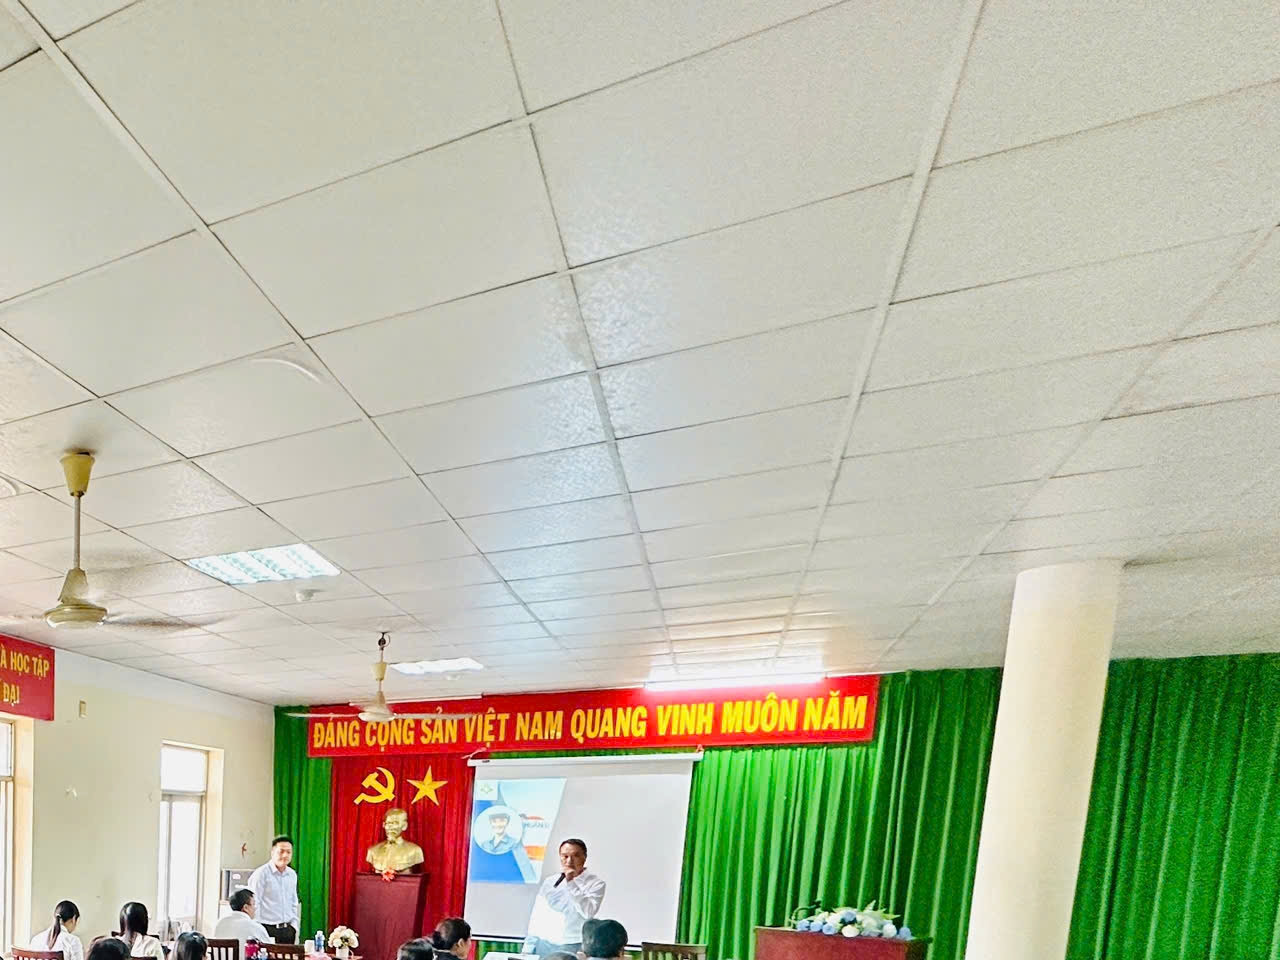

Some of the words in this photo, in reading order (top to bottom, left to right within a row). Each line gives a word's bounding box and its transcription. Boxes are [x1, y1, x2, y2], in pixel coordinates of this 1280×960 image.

[10, 651, 30, 676] HỌC
[32, 654, 50, 680] TẬP
[3, 682, 21, 707] ĐẠI
[313, 712, 360, 748] ĐẢNG
[421, 706, 458, 745] SẢN
[464, 707, 510, 748] VIỆT
[515, 710, 564, 742] NAM
[570, 706, 648, 743] QUANG
[656, 703, 715, 736] VINH
[721, 691, 799, 734] MUÔN
[803, 690, 868, 731] NĂM
